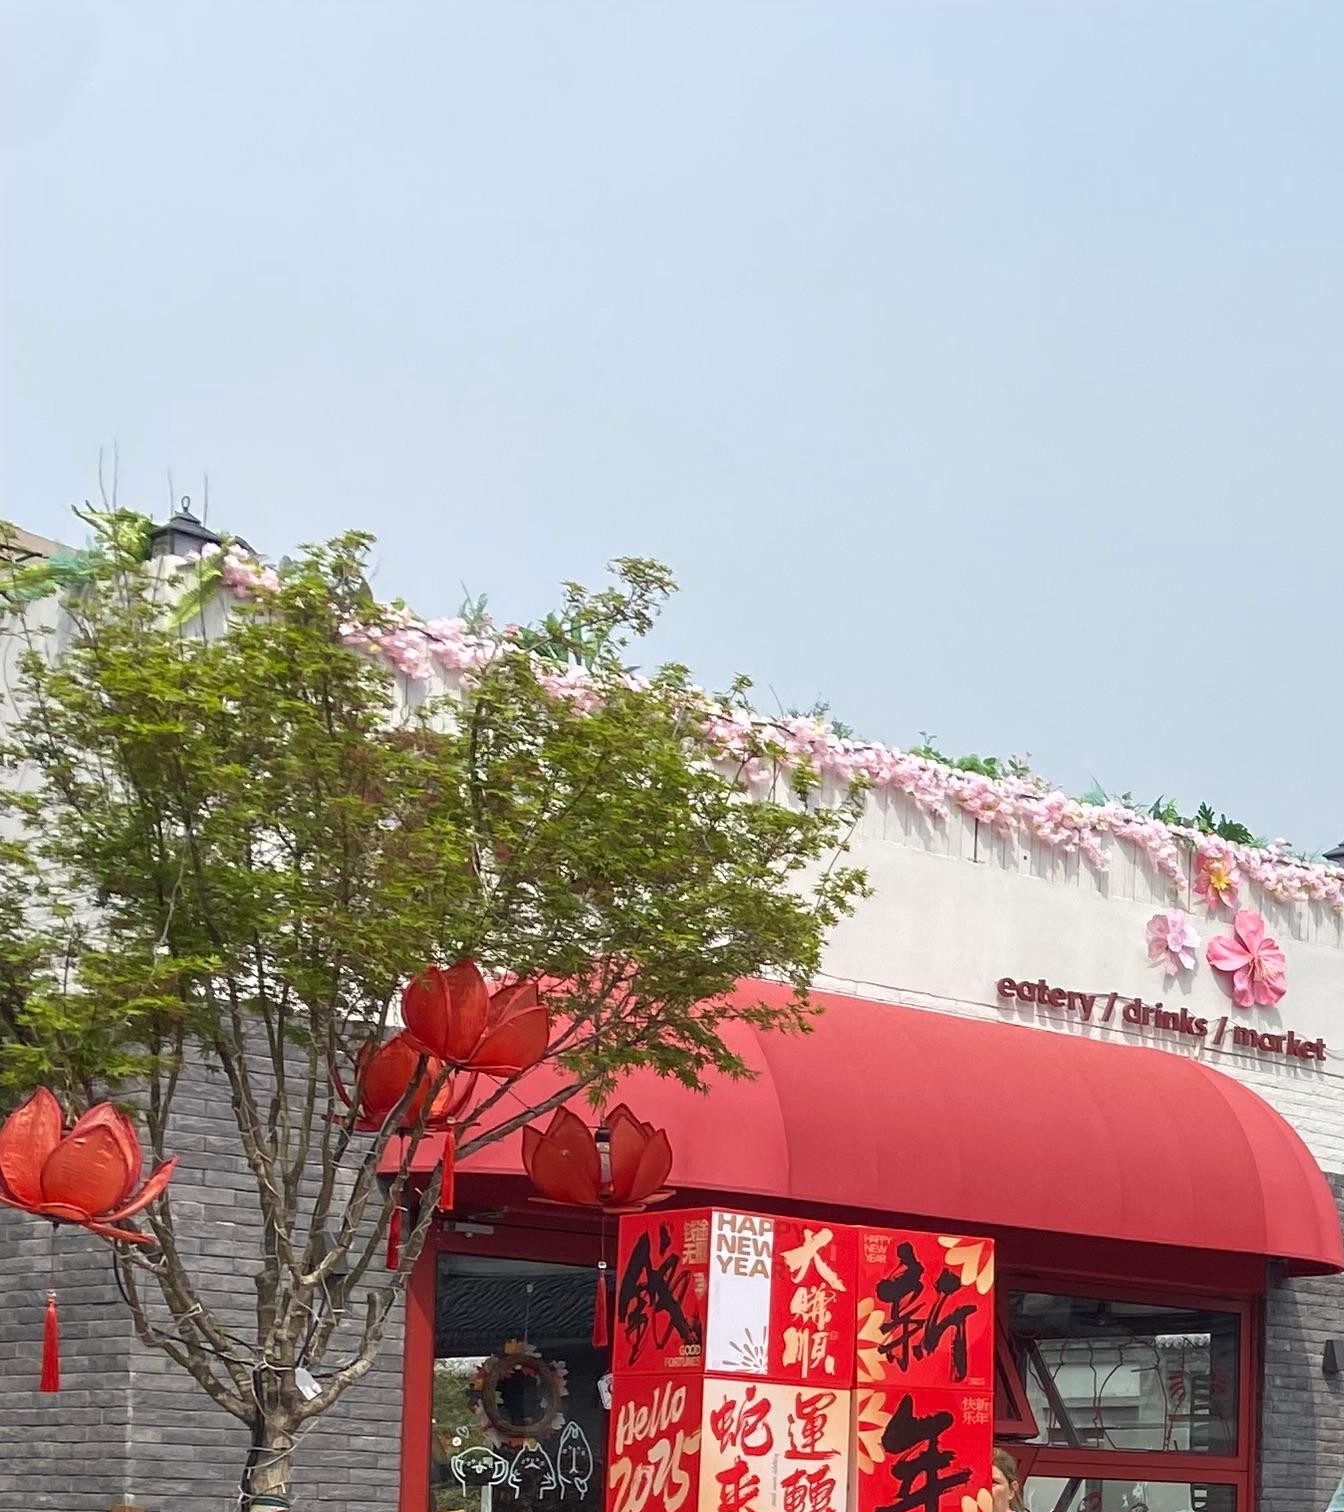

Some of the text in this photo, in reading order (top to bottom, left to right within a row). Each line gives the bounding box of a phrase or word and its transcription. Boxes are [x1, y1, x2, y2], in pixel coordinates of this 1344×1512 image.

[997, 976, 1097, 1021] eatery
[1122, 998, 1208, 1037] drinks
[1233, 1024, 1327, 1061] market
[717, 1234, 772, 1258] NEW
[679, 1344, 701, 1356] GOOD
[615, 1380, 687, 1455] Hello
